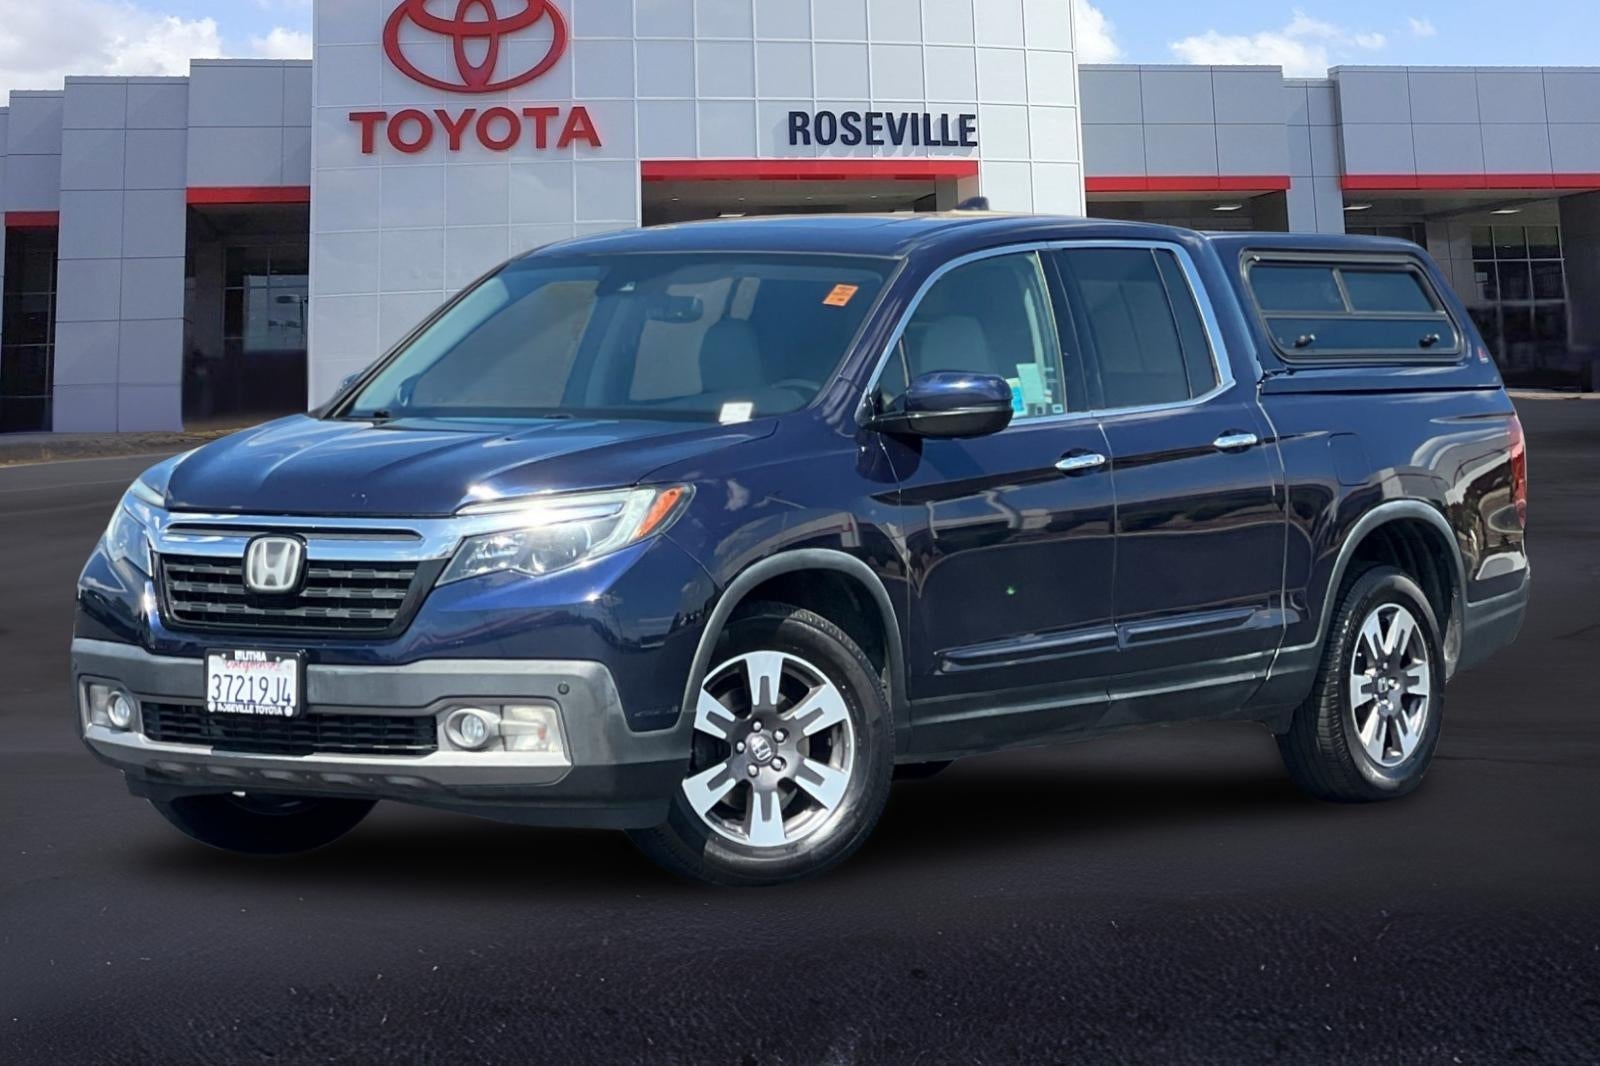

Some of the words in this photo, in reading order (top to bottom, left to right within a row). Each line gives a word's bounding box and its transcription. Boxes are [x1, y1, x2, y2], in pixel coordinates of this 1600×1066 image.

[349, 106, 602, 154] TOYOTA
[788, 110, 978, 147] ROSEVILLE
[211, 673, 292, 706] 37219J4
[255, 704, 283, 715] TOYOTA
